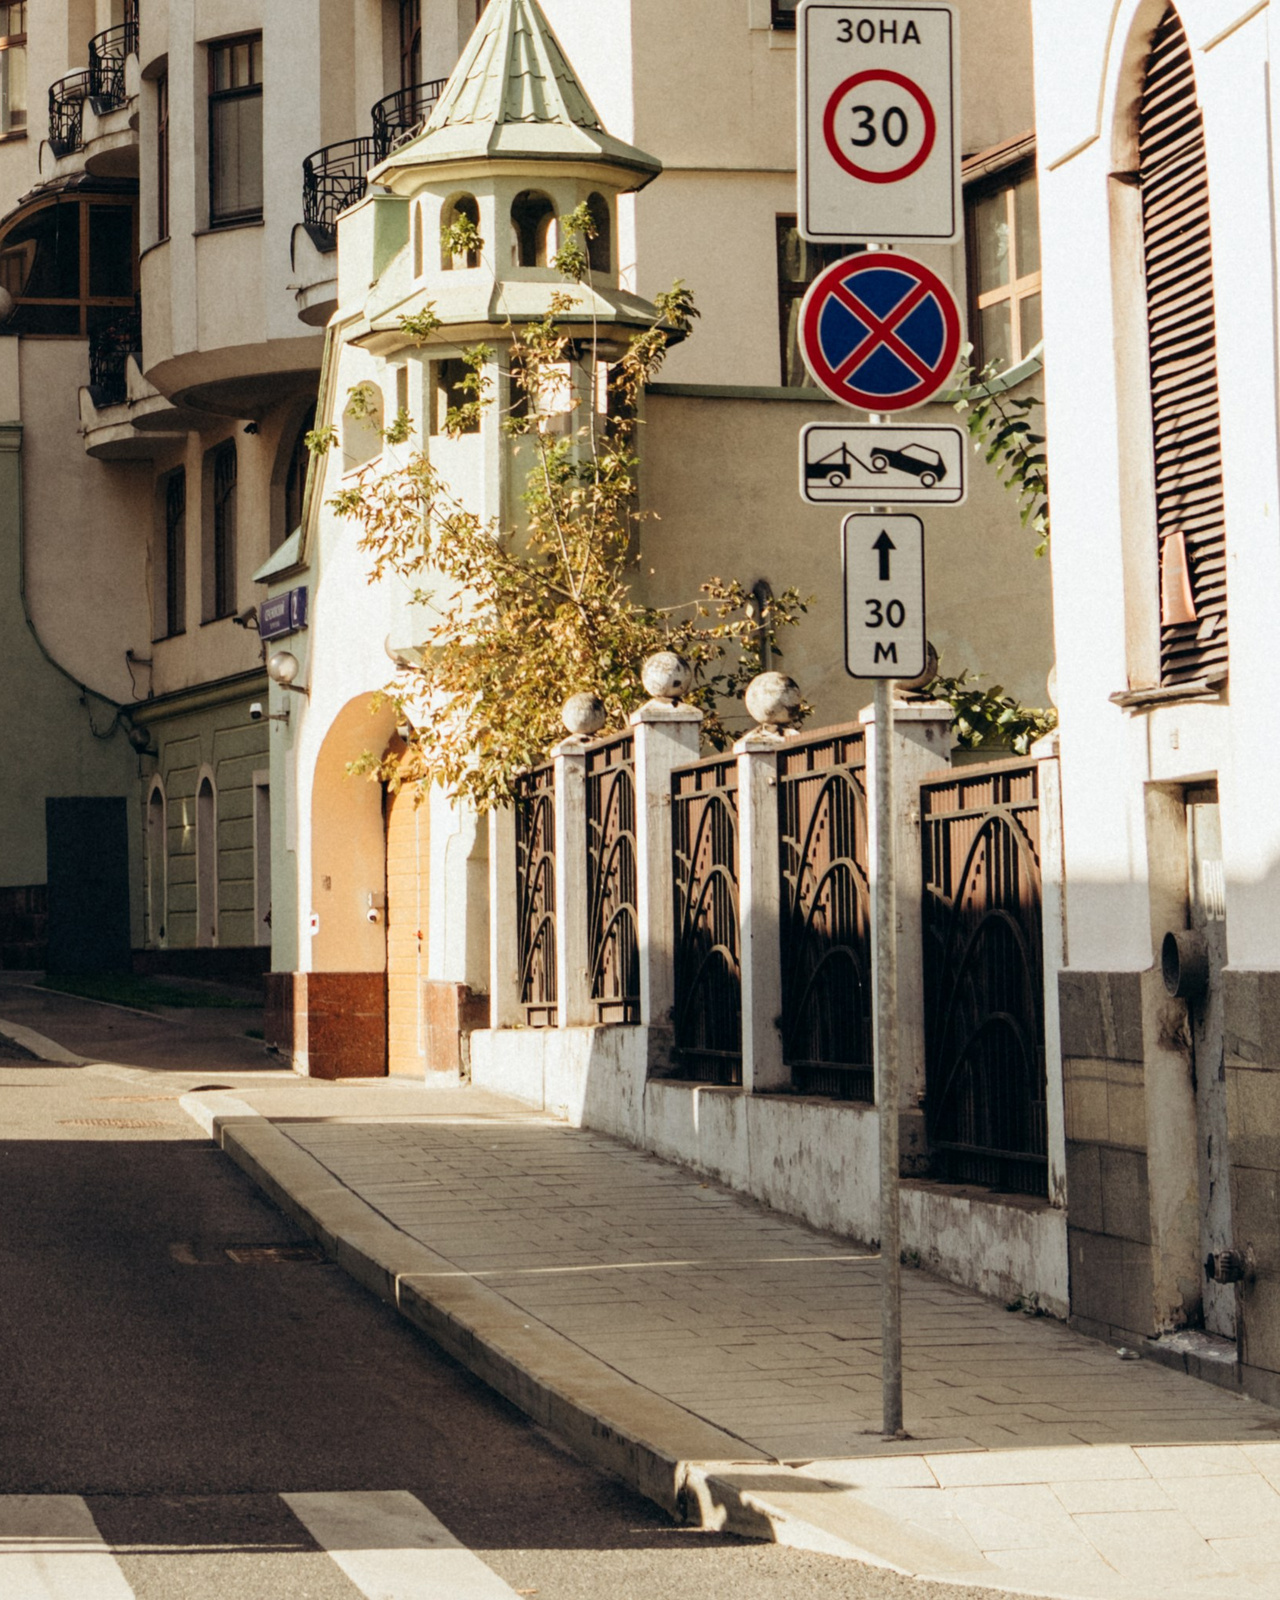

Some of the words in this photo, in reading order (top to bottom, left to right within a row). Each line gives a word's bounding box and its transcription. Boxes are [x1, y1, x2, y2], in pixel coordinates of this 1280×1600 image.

[836, 18, 921, 45] ЗОНА
[850, 105, 909, 148] 30
[864, 598, 906, 629] 30
